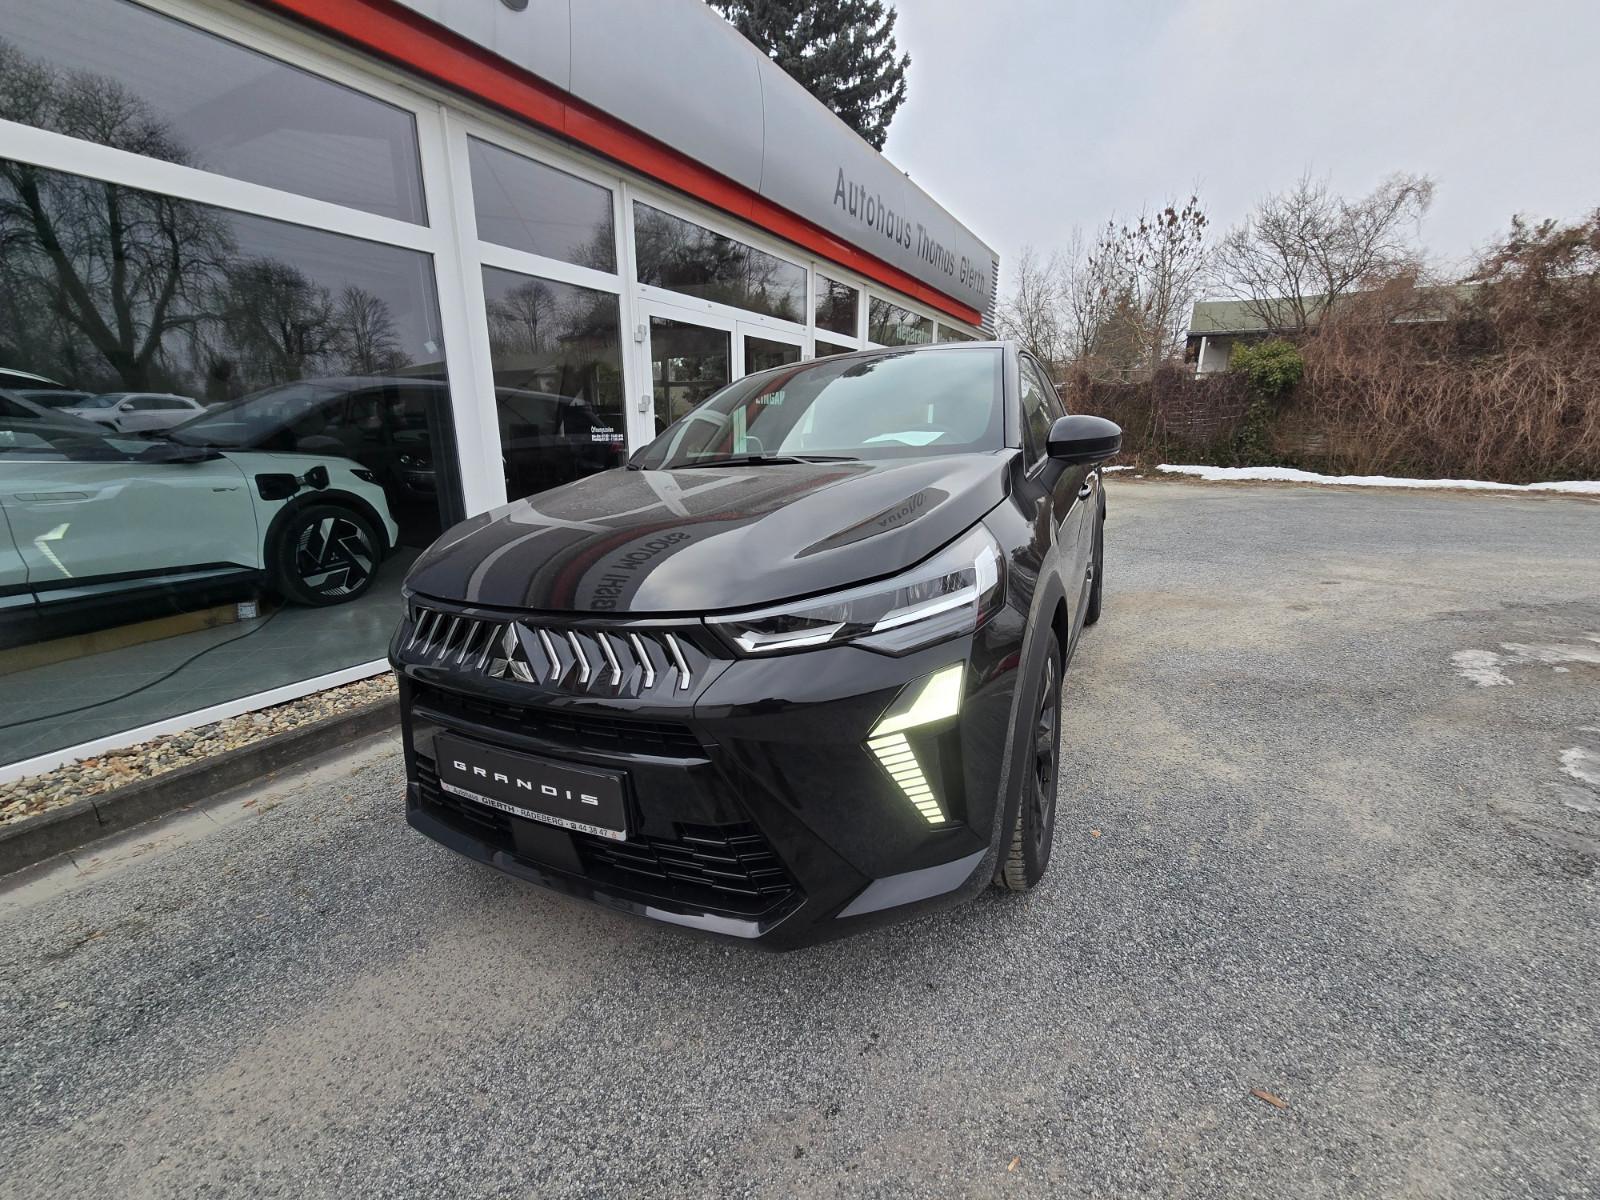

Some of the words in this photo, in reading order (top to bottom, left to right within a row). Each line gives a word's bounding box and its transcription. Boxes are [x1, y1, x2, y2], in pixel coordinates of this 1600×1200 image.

[833, 167, 911, 250] Autohaus
[916, 223, 955, 276] Thomas
[959, 255, 985, 296] Gierth
[453, 760, 599, 806] GRANDIS
[481, 796, 515, 814] GIERTH
[520, 809, 564, 827] RADEBERG
[578, 823, 588, 832] 44
[598, 829, 608, 838] 47
